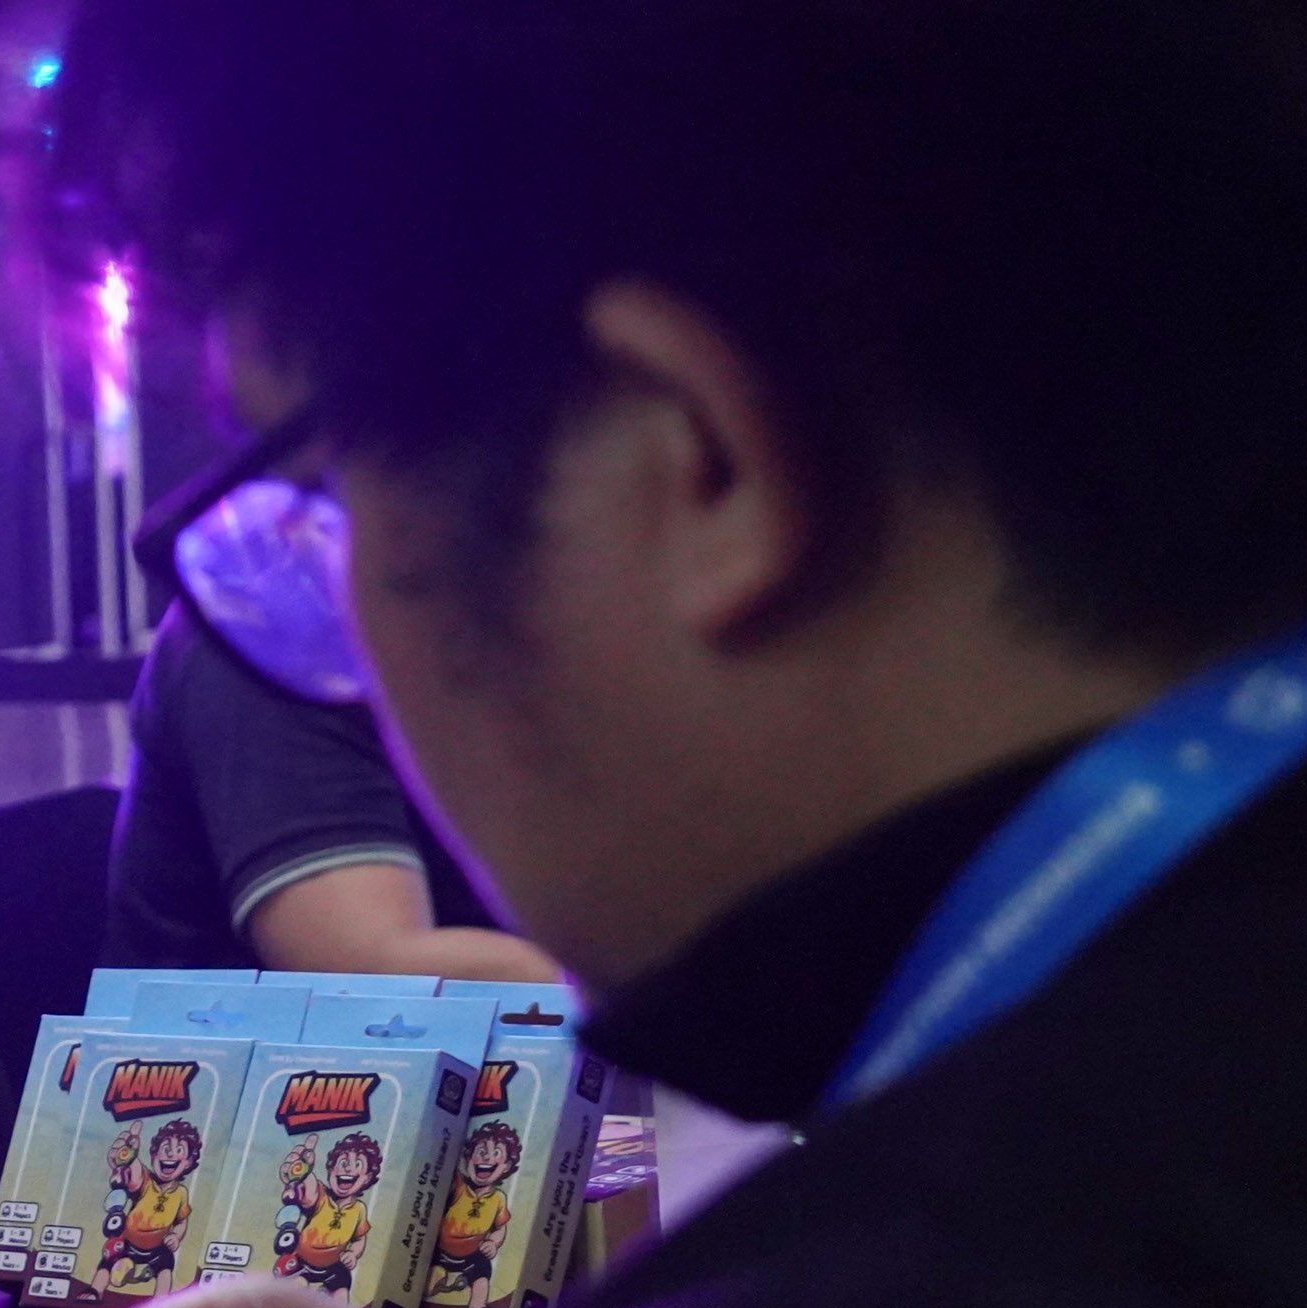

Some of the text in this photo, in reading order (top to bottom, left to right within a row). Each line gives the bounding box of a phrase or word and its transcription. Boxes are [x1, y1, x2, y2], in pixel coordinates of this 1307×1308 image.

[105, 1063, 193, 1105] MANIK
[279, 1075, 375, 1115] MANIK
[412, 1190, 424, 1219] you
[403, 1231, 425, 1293] Greatest
